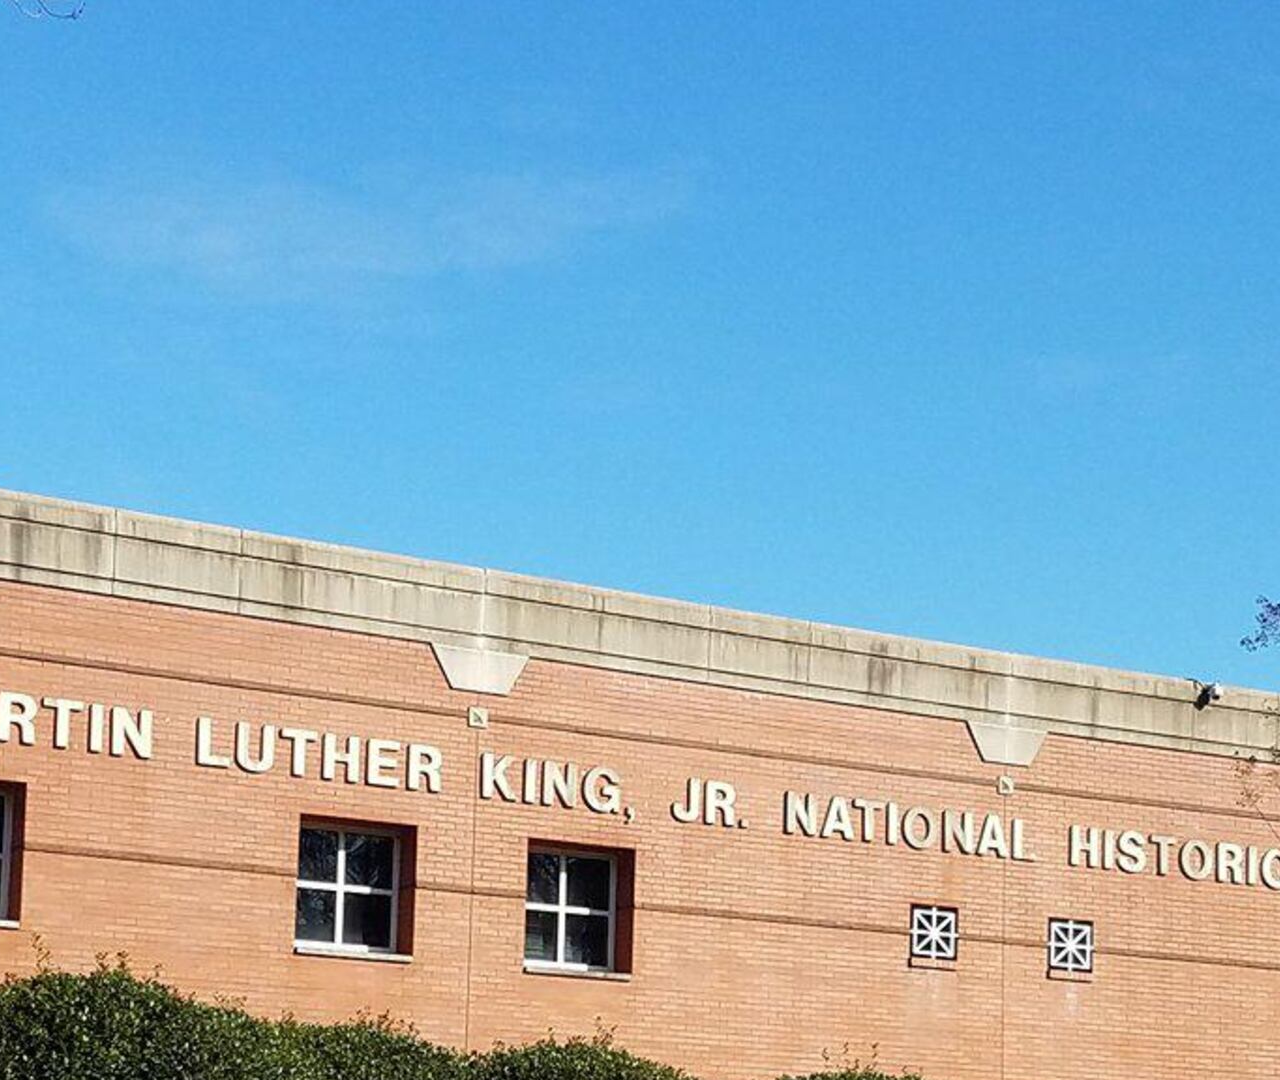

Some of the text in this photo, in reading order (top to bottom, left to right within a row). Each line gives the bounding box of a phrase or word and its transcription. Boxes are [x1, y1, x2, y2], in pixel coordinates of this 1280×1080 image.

[195, 716, 444, 793] LUTHER
[480, 751, 636, 823] KING,
[671, 778, 748, 830] JR.
[782, 791, 1036, 864] NATIONAL
